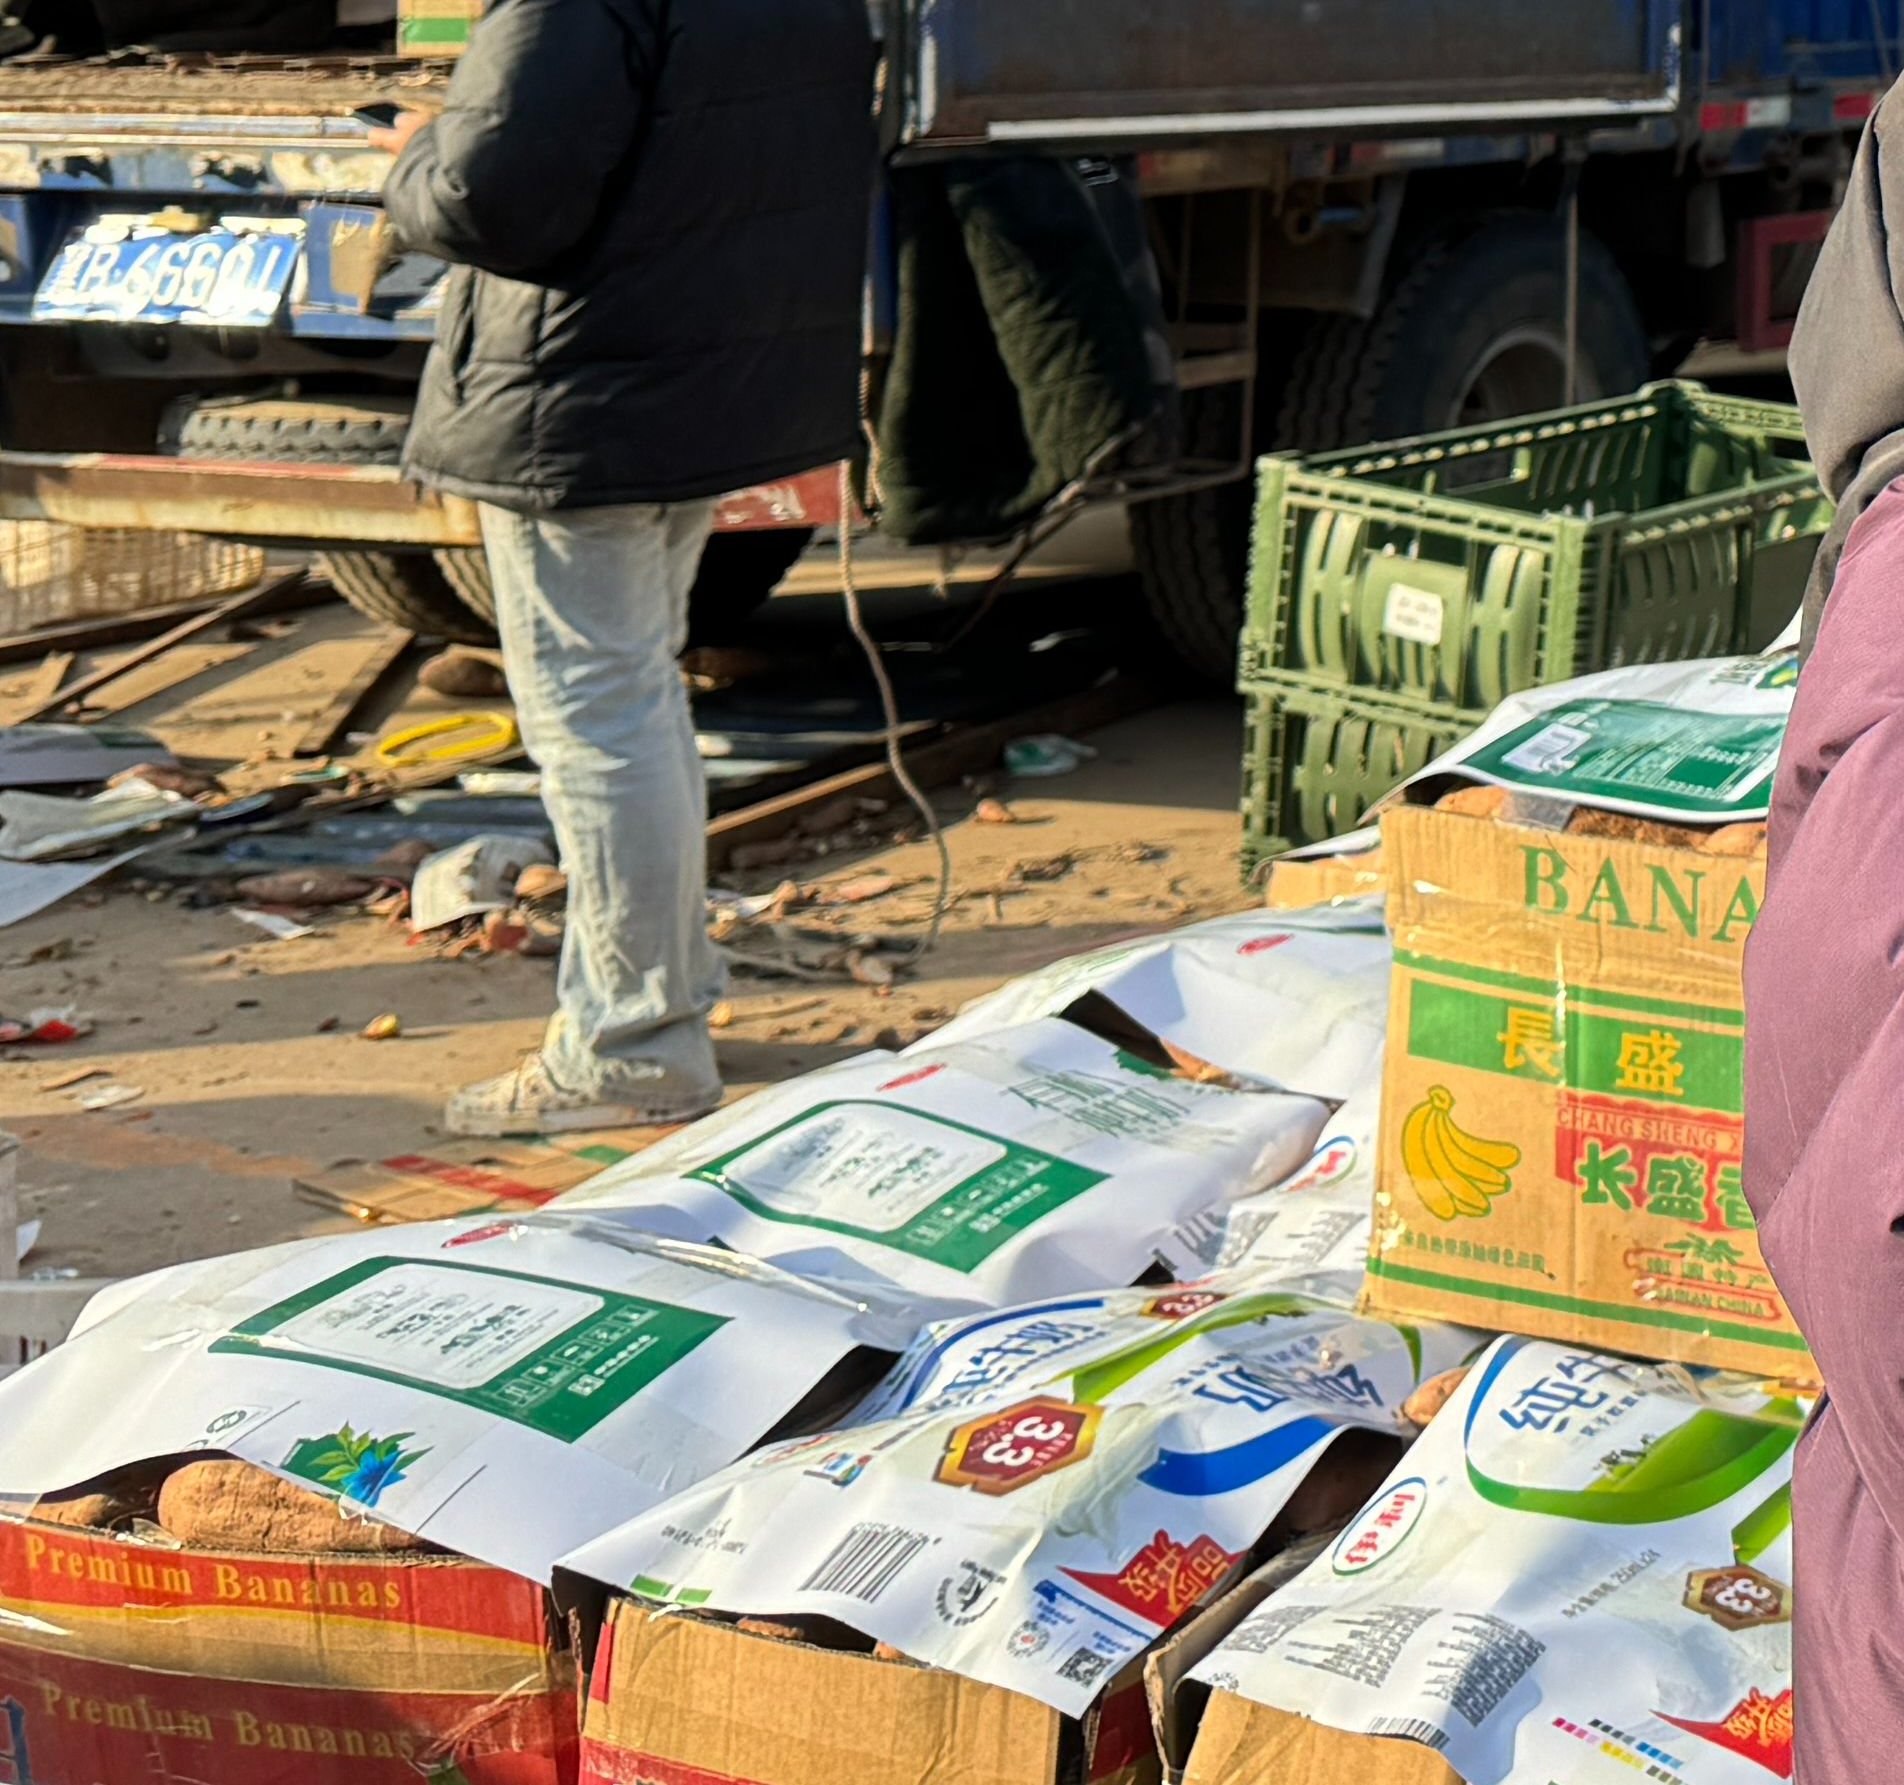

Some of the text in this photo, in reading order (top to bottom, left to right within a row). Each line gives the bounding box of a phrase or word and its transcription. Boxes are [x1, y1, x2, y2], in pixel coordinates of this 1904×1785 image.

[1496, 1006, 1684, 1096] 長盛
[1557, 1107, 1633, 1136] CHANG
[1641, 1122, 1716, 1148] SHENG
[1497, 1349, 1640, 1434] 纯牛
[983, 1414, 1065, 1469] 3.3
[25, 1534, 402, 1610] Premium Bananas
[42, 1681, 214, 1742] Premium
[235, 1710, 417, 1760] Bananas
